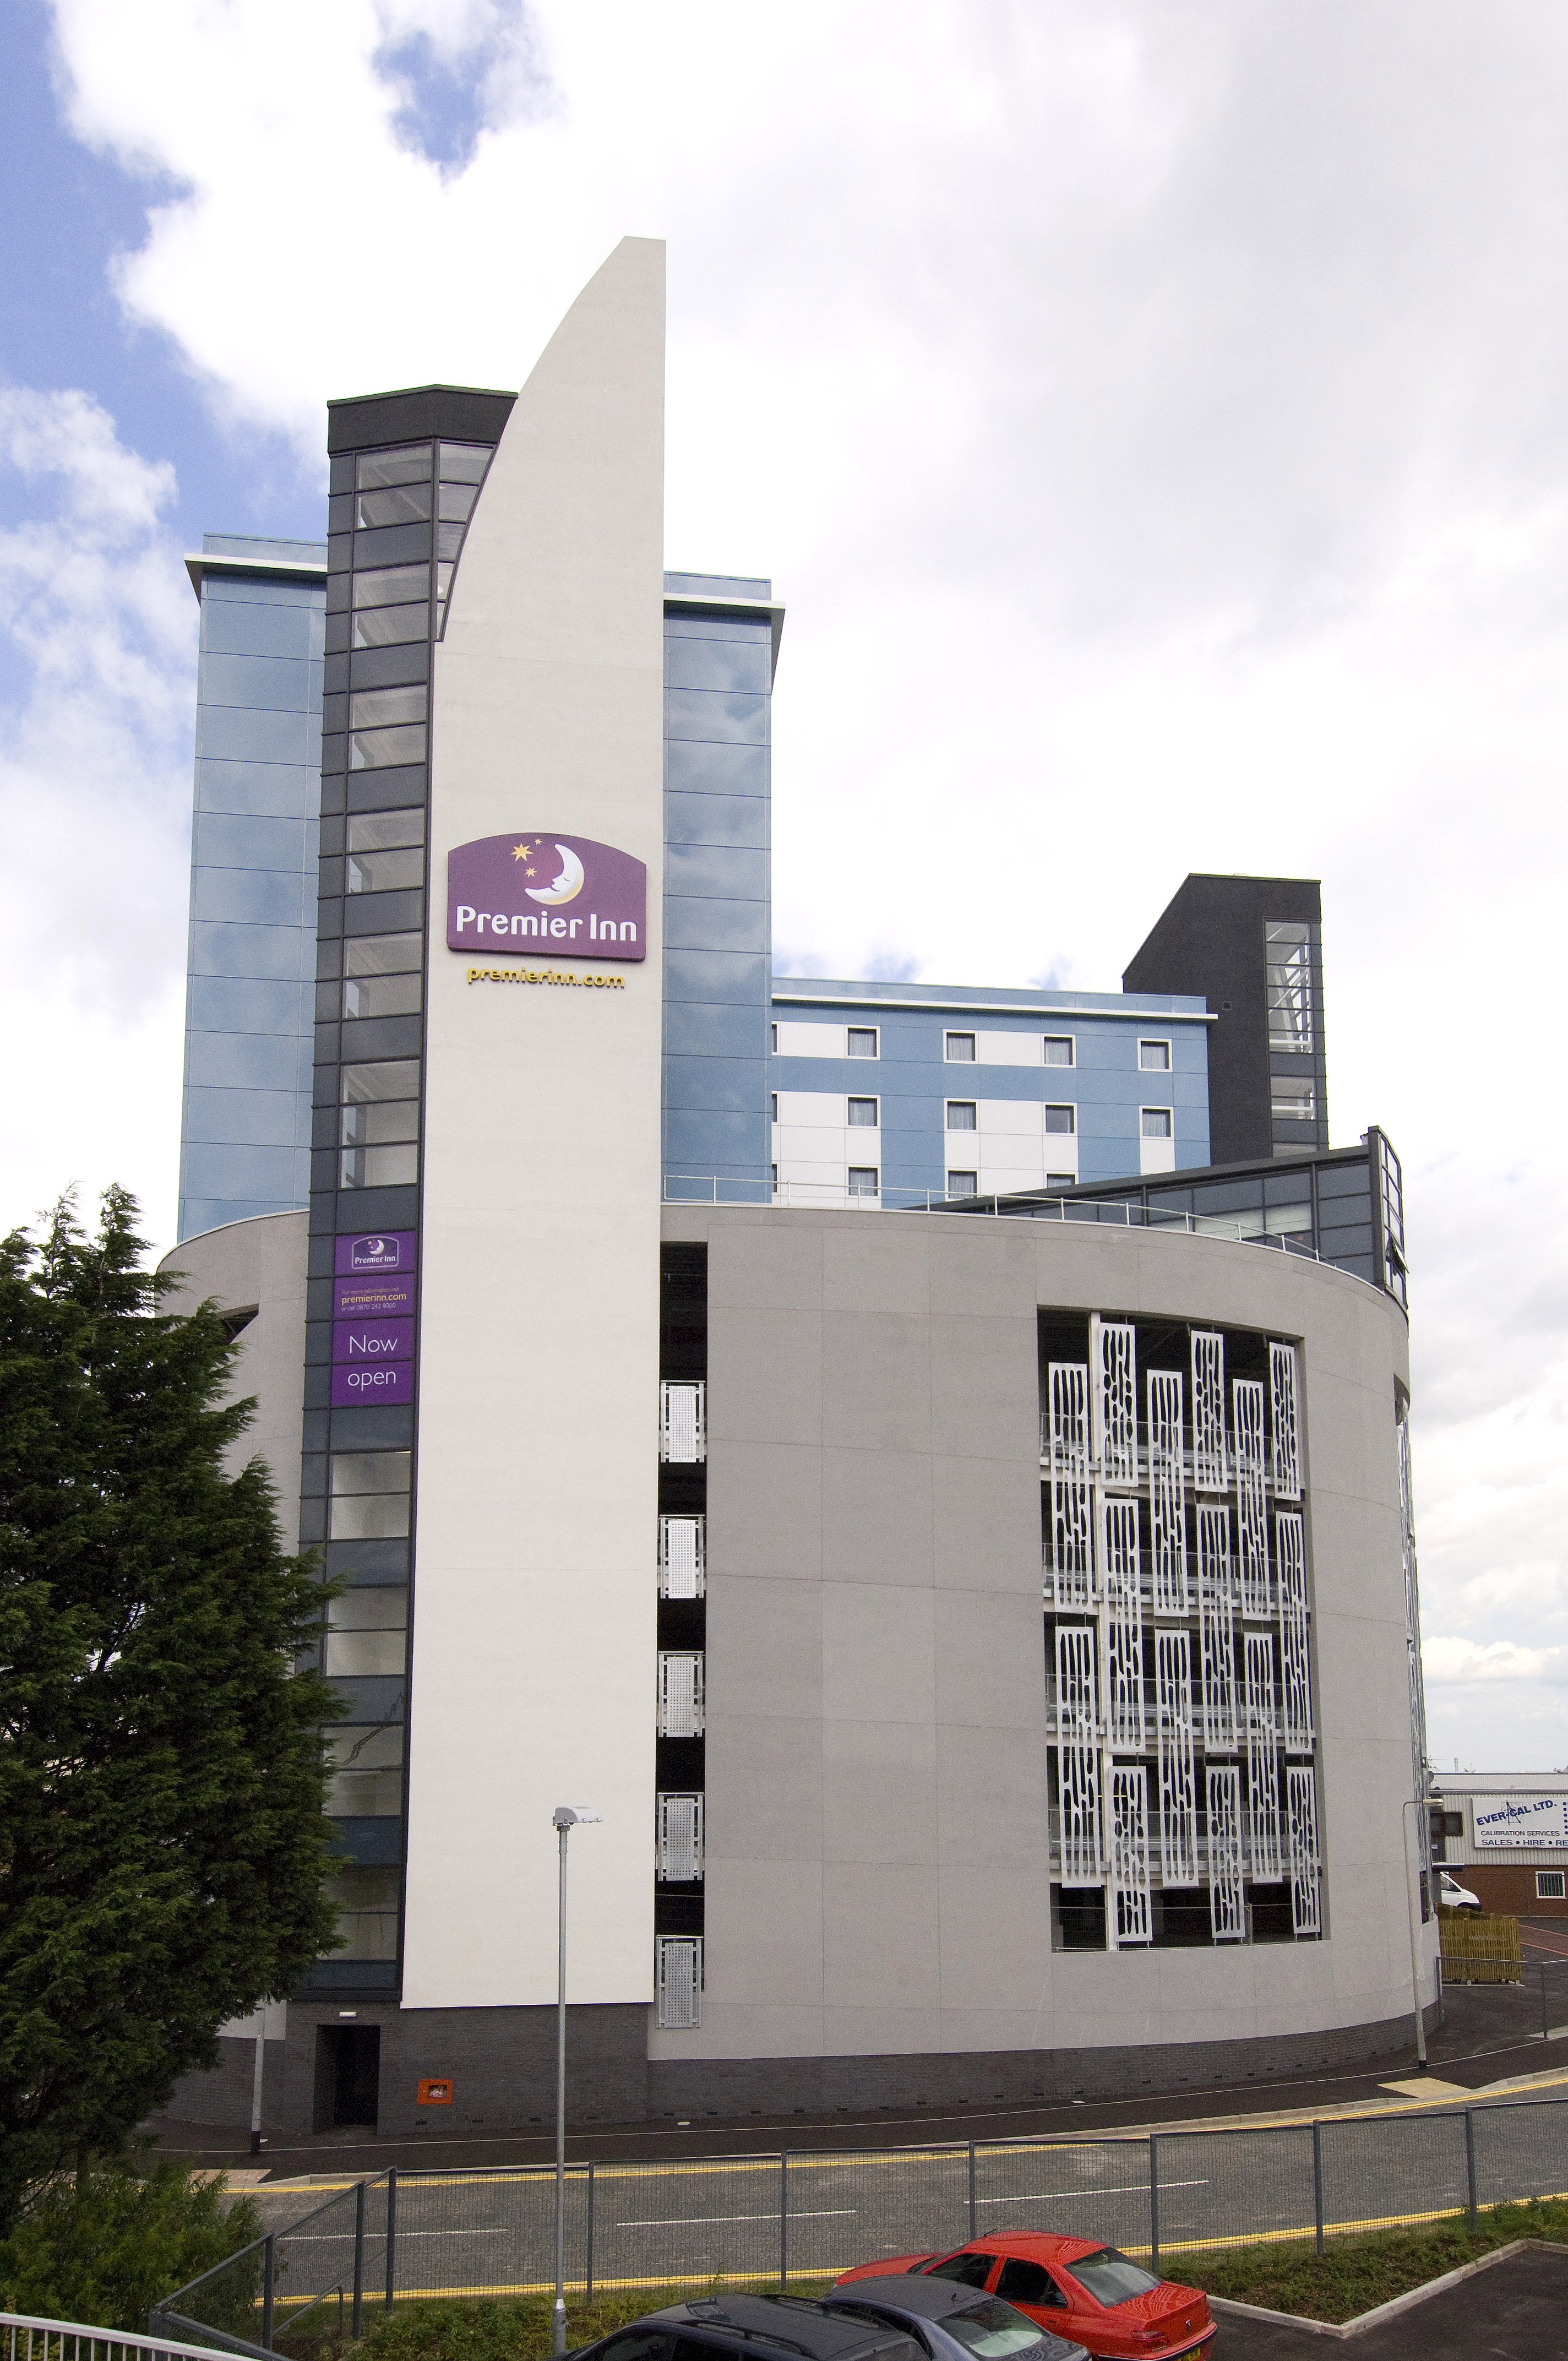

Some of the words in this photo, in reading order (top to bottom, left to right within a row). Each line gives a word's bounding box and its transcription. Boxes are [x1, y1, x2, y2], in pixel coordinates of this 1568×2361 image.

[456, 905, 583, 938] Premier
[590, 913, 636, 942] Inn
[468, 967, 625, 988] premierinn.com
[355, 1255, 384, 1264] Premier
[341, 1293, 407, 1306] premierinn.com
[350, 1335, 398, 1354] Now
[347, 1371, 396, 1391] open
[1533, 1800, 1557, 1811] LTD.
